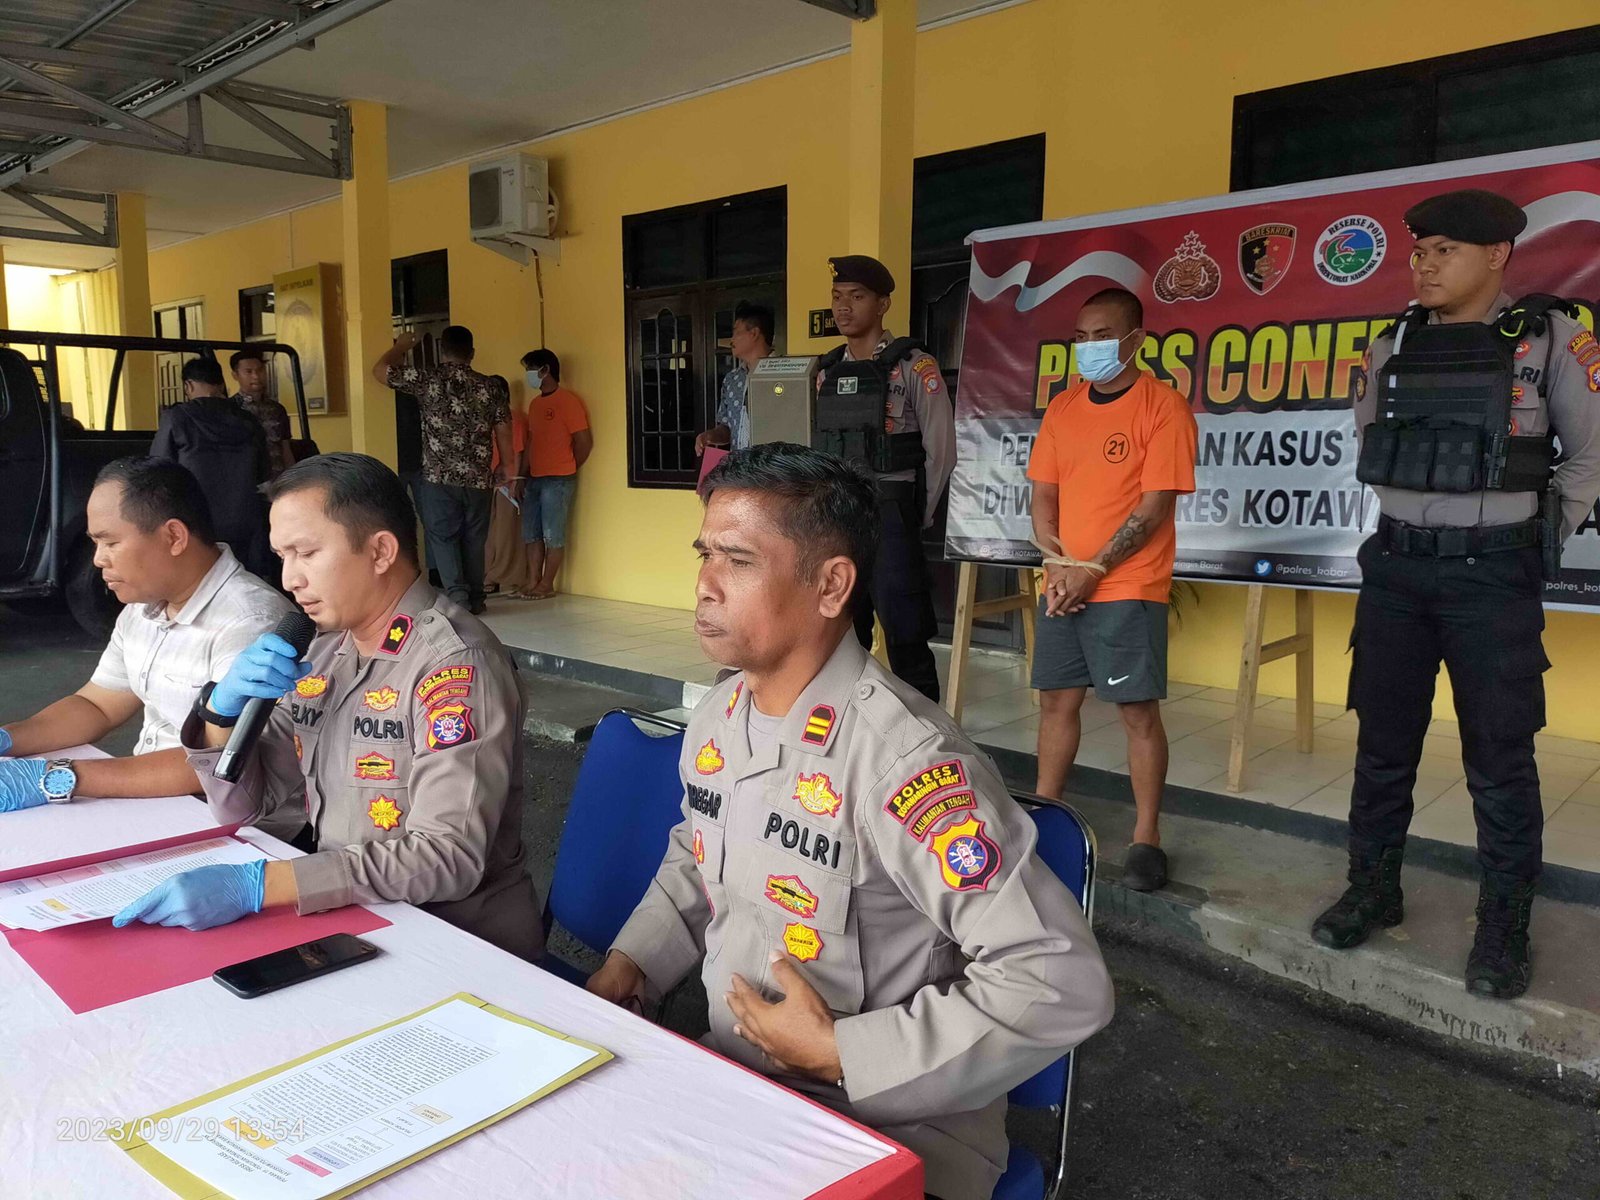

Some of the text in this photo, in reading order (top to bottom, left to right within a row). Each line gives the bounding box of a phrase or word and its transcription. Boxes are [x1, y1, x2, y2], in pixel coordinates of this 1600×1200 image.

[1245, 226, 1290, 240] BARESKRIM
[1327, 217, 1385, 249] RESERSE POLRI
[813, 313, 820, 334] 5
[1207, 318, 1397, 405] CONF
[1107, 440, 1125, 455] 21
[1232, 430, 1343, 467] KASUS
[984, 485, 1008, 515] DI
[1242, 489, 1380, 527] KOTAW
[1275, 563, 1348, 577] @polres_kobar
[418, 668, 469, 698] POLRES
[353, 715, 405, 739] POLRI
[893, 765, 952, 807] POLRES
[912, 795, 970, 836] KALIMANTAN TENGAH
[764, 812, 842, 869] POLRI
